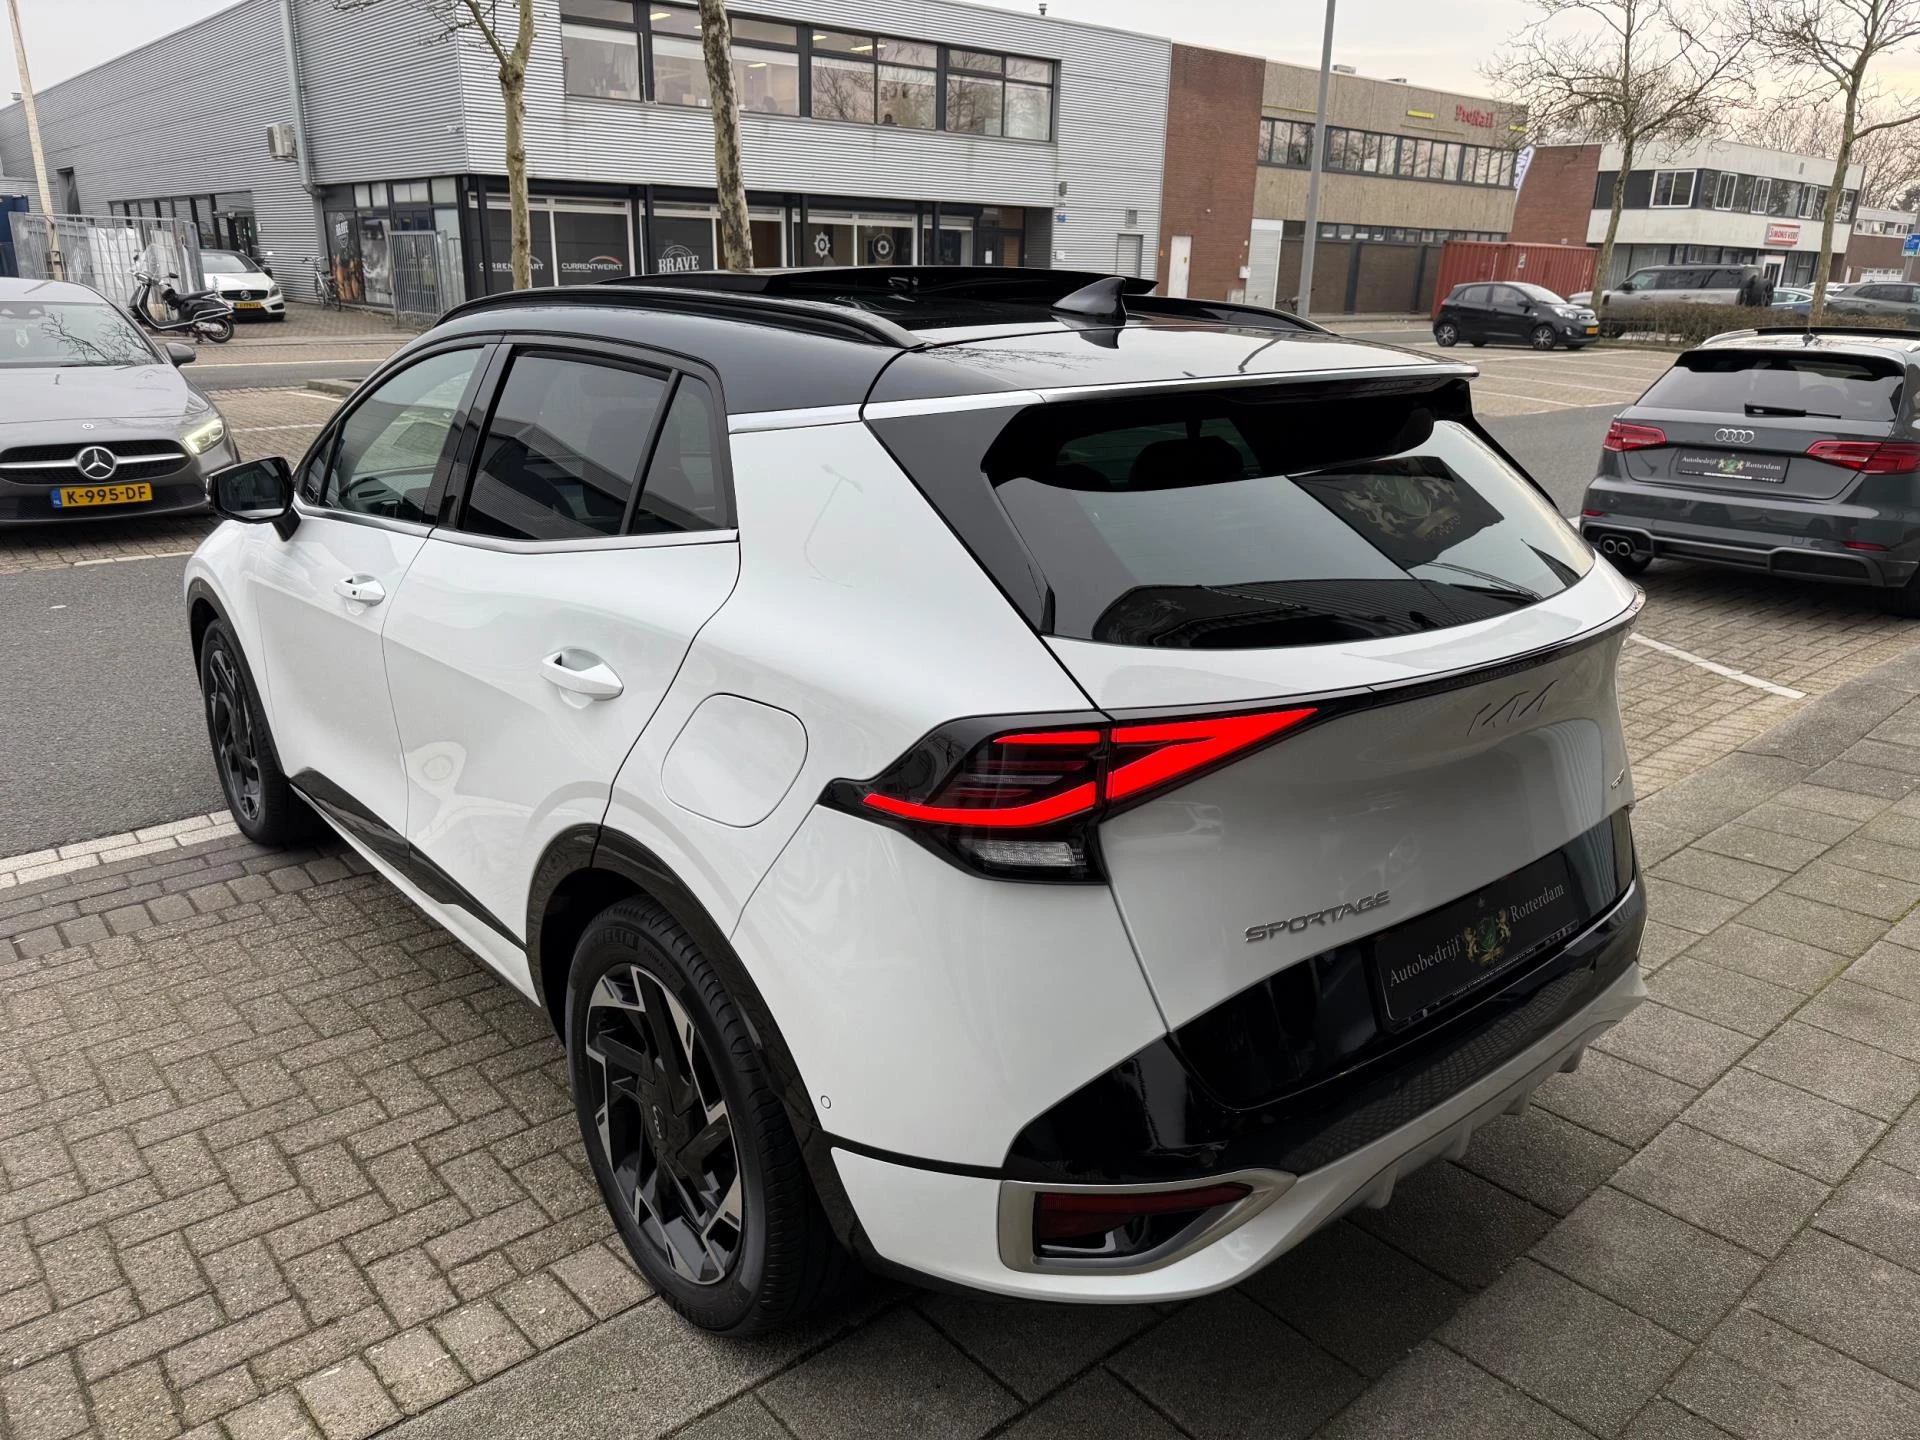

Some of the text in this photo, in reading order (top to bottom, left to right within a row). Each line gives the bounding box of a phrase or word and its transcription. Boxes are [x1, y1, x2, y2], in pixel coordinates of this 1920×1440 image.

[561, 262, 623, 271] CURRENTWERKT
[658, 255, 699, 273] BRAVE
[66, 485, 146, 505] K-995-DF
[1244, 889, 1391, 943] SPORTAGE
[1389, 935, 1461, 987] Autobedrijf
[1510, 883, 1565, 923] Rotterdam
